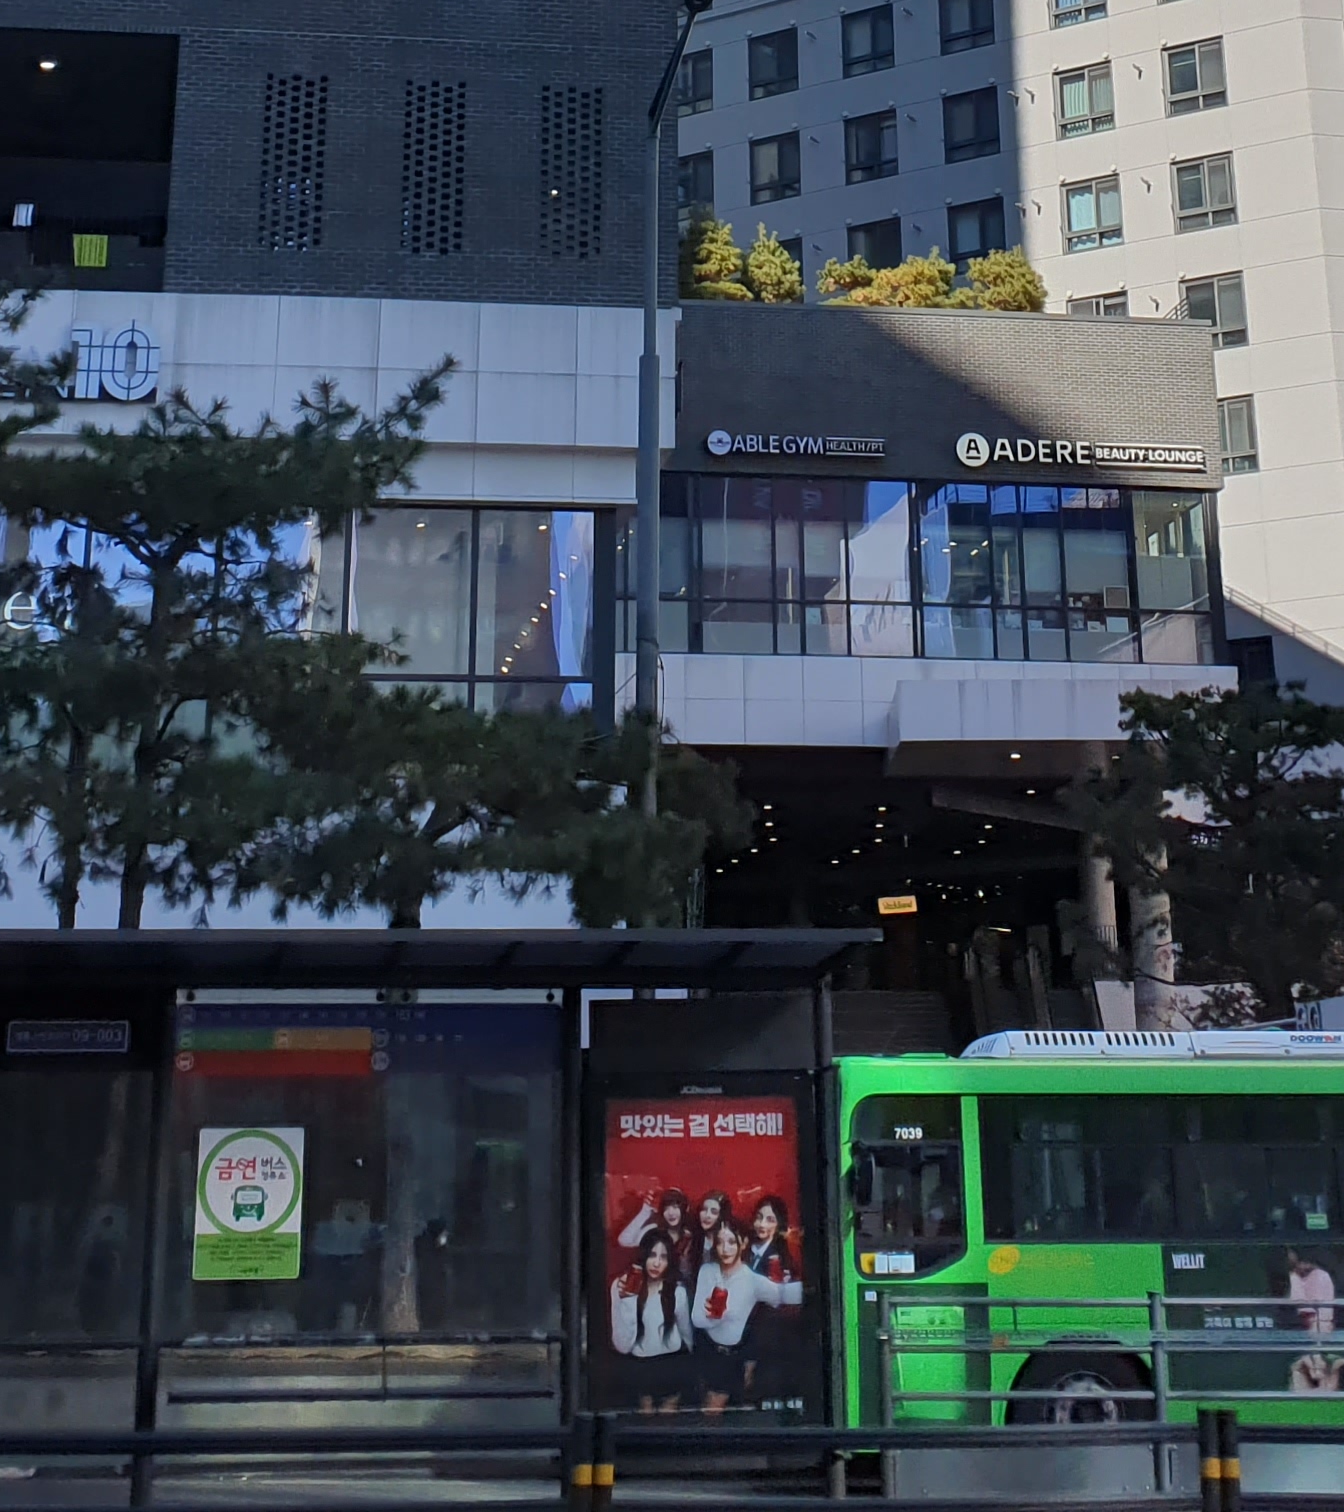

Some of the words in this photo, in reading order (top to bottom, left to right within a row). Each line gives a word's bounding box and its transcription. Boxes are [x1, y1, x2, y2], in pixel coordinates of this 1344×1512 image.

[732, 434, 781, 454] ABLE
[782, 435, 824, 455] GYM
[825, 439, 885, 453] HEALTH/PT
[993, 438, 1092, 465] ADERE
[1095, 446, 1146, 462] BEAUTY
[1147, 448, 1205, 464] LOUNGE
[620, 1113, 685, 1139] 맛있는
[688, 1113, 710, 1138] 걸
[713, 1112, 784, 1137] 선택해!
[893, 1126, 924, 1140] 7039
[214, 1156, 257, 1181] 금연
[260, 1156, 288, 1171] 버스
[1171, 1252, 1206, 1270] WELLIT
